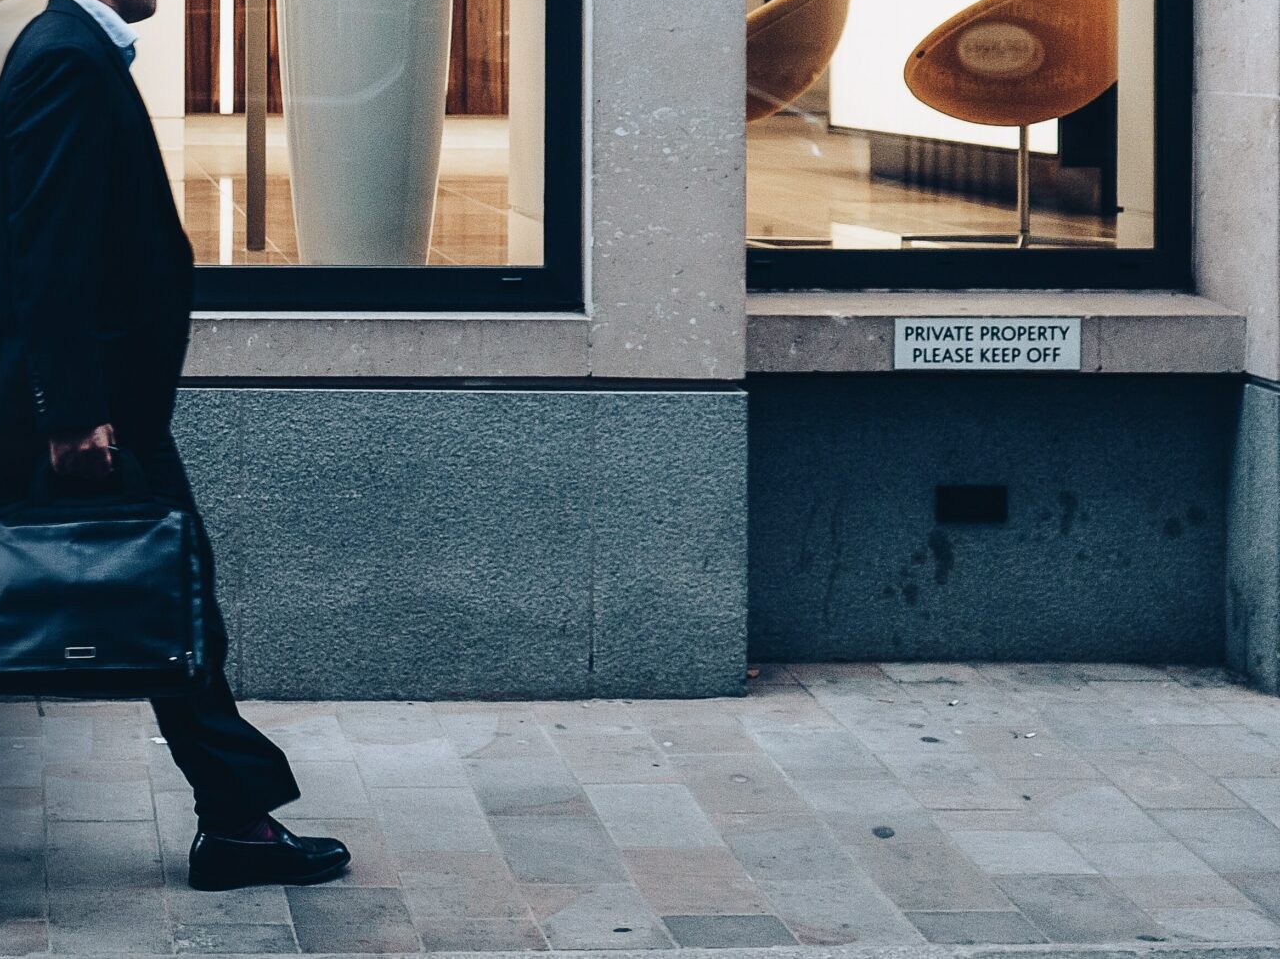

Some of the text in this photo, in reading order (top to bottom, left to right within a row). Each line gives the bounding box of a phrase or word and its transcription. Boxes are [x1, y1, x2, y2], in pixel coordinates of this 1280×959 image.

[904, 326, 1070, 342] PRIVATE PROPERTY
[913, 347, 1061, 363] PLEASE KEEP OFF
